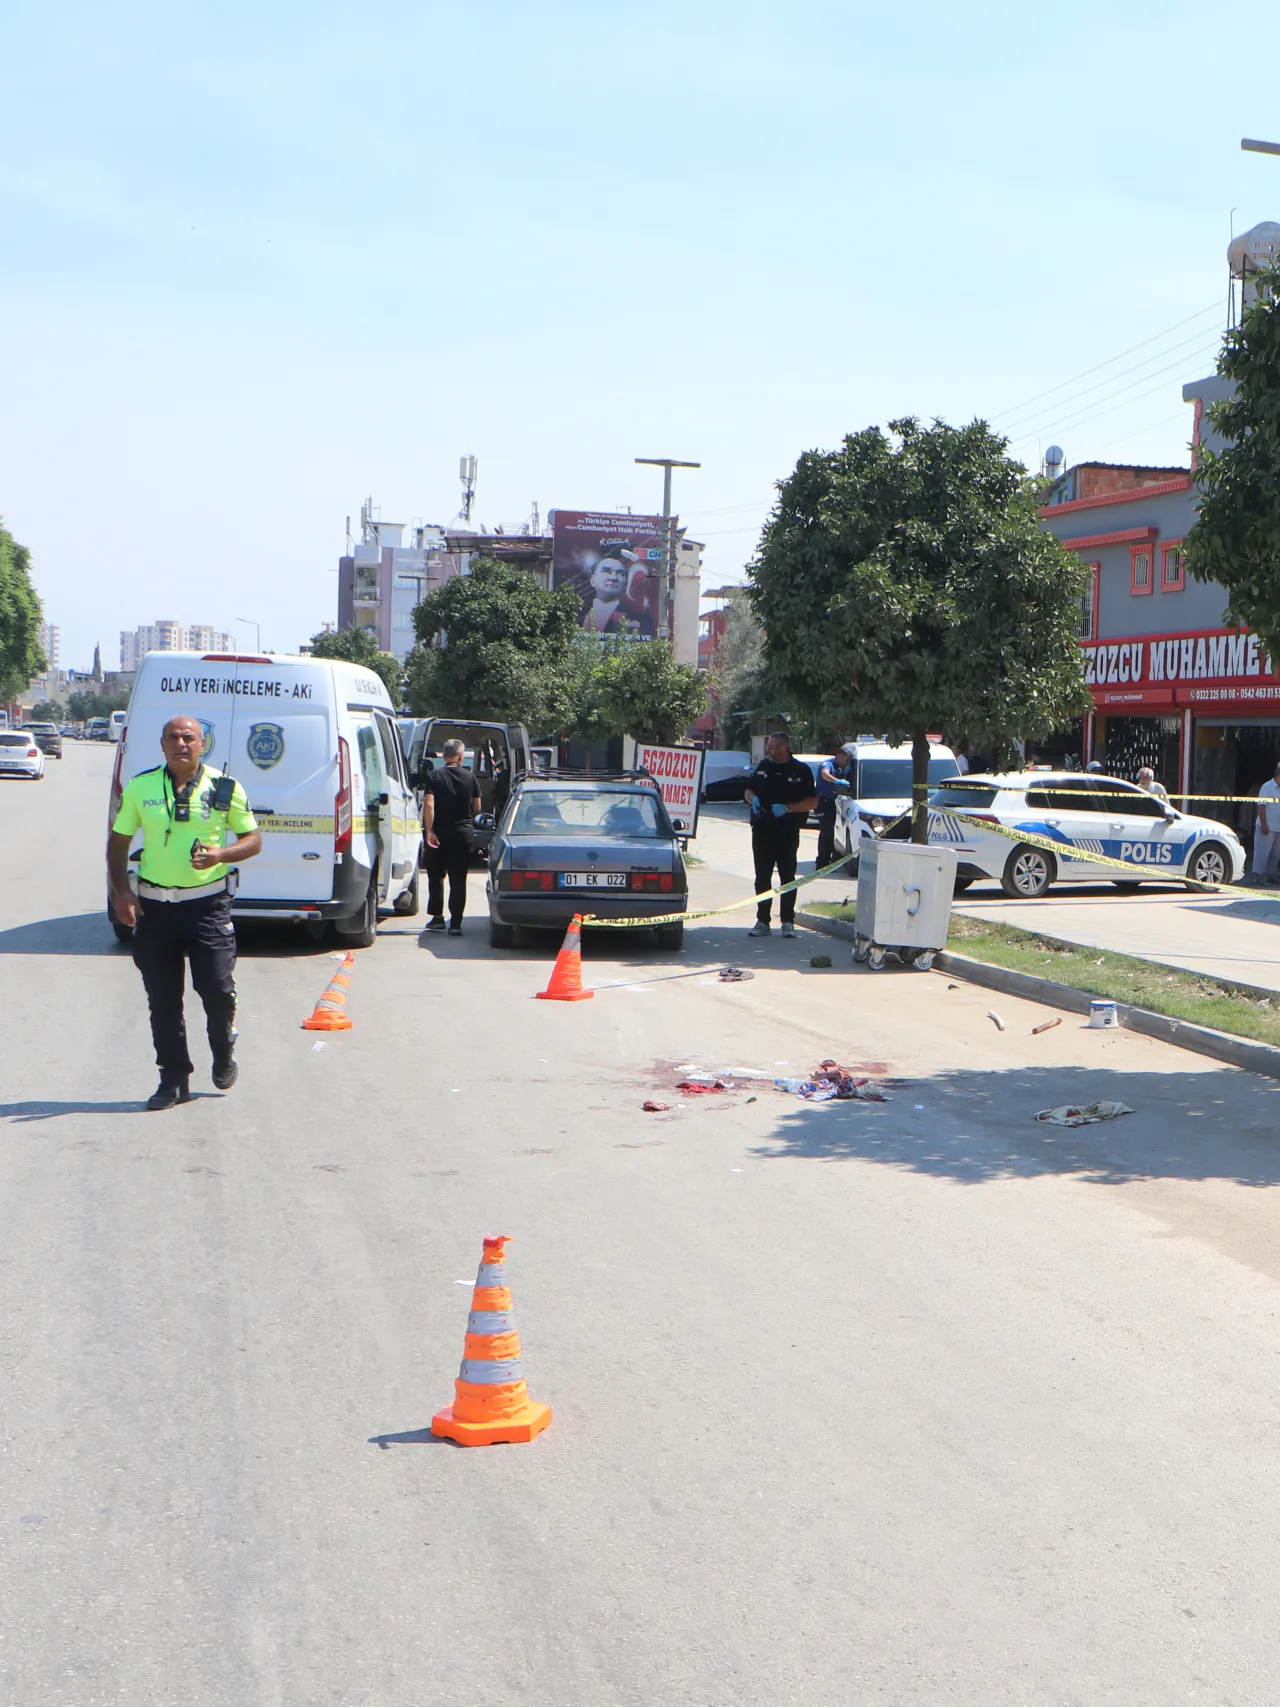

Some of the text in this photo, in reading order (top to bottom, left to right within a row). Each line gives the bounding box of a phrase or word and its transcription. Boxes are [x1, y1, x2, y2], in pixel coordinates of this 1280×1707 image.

[161, 677, 191, 693] OLAY
[643, 749, 698, 780] EGZOZCU
[565, 873, 626, 886] 01 EK 022
